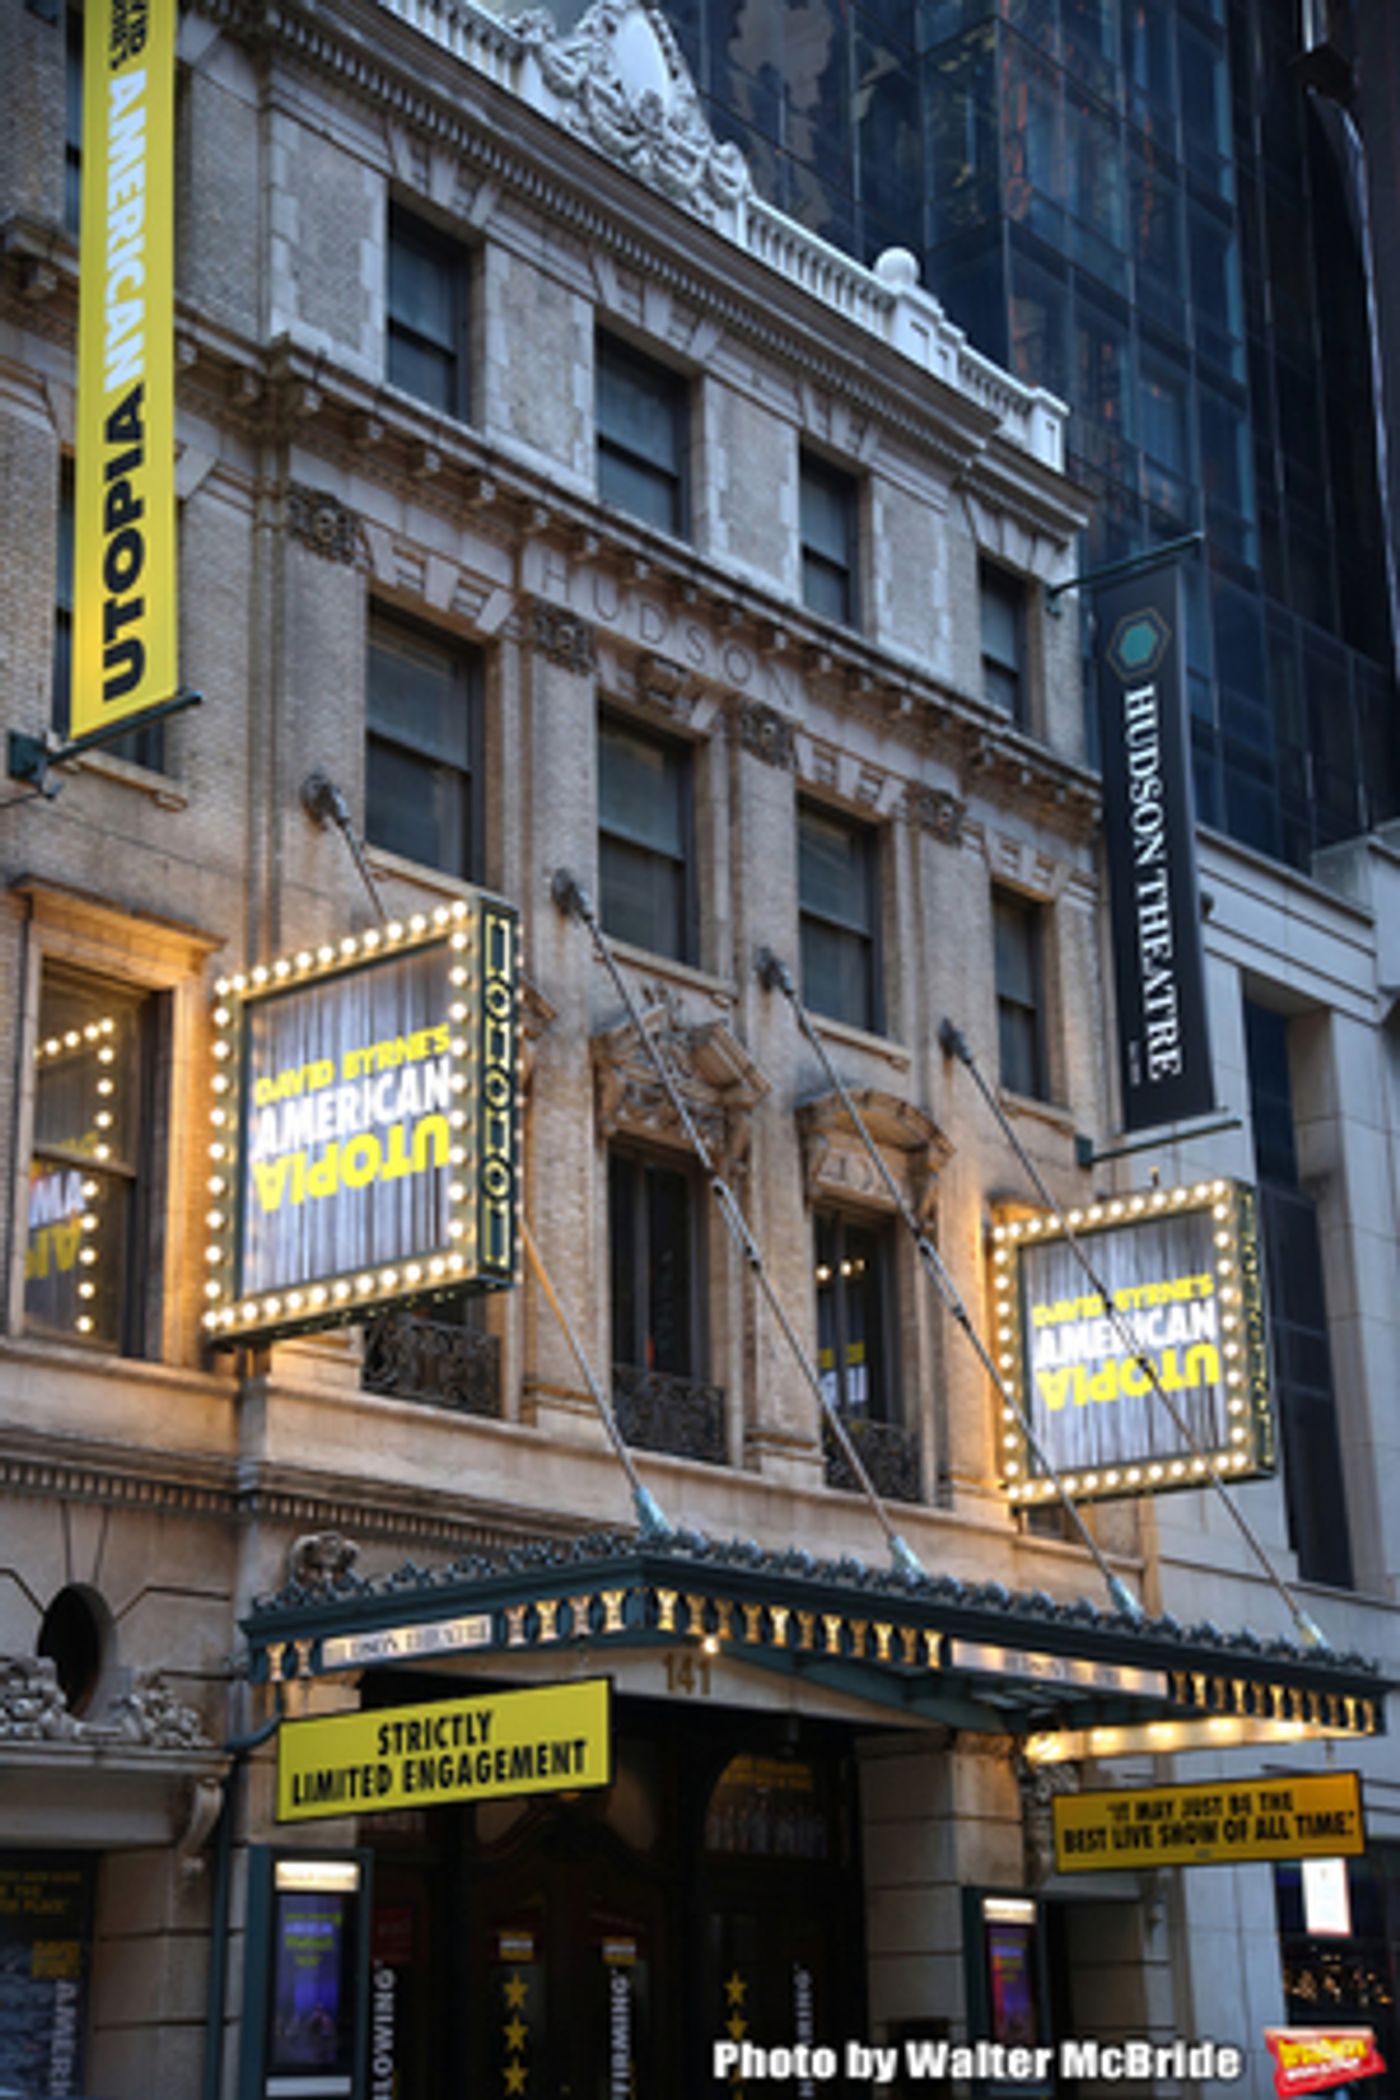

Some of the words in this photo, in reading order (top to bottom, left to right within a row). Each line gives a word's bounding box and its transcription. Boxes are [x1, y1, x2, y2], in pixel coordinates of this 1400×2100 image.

[102, 68, 147, 394] AMERICAN
[103, 381, 145, 702] UTOPIA
[541, 546, 794, 706] HUDSON
[1124, 684, 1166, 867] HUDSON
[1136, 867, 1182, 1083] THEATRE
[252, 1058, 451, 1157] AMERICAN
[254, 1060, 336, 1107] DAVID
[252, 1114, 451, 1214] UTOPIA
[1034, 1300, 1217, 1370] AMERICAN
[1035, 1343, 1221, 1412] UTOPIA
[662, 1652, 711, 1695] 141
[291, 1763, 393, 1807] LIMITED
[402, 1739, 586, 1793] ENGAGEMENT
[377, 1710, 493, 1757] STRICTLY
[1063, 1827, 1108, 1854] BEST
[1111, 1824, 1154, 1850] LIVE
[1157, 1820, 1219, 1846] SHOW
[1223, 1818, 1248, 1843] OF
[1254, 1815, 1291, 1841] ALL
